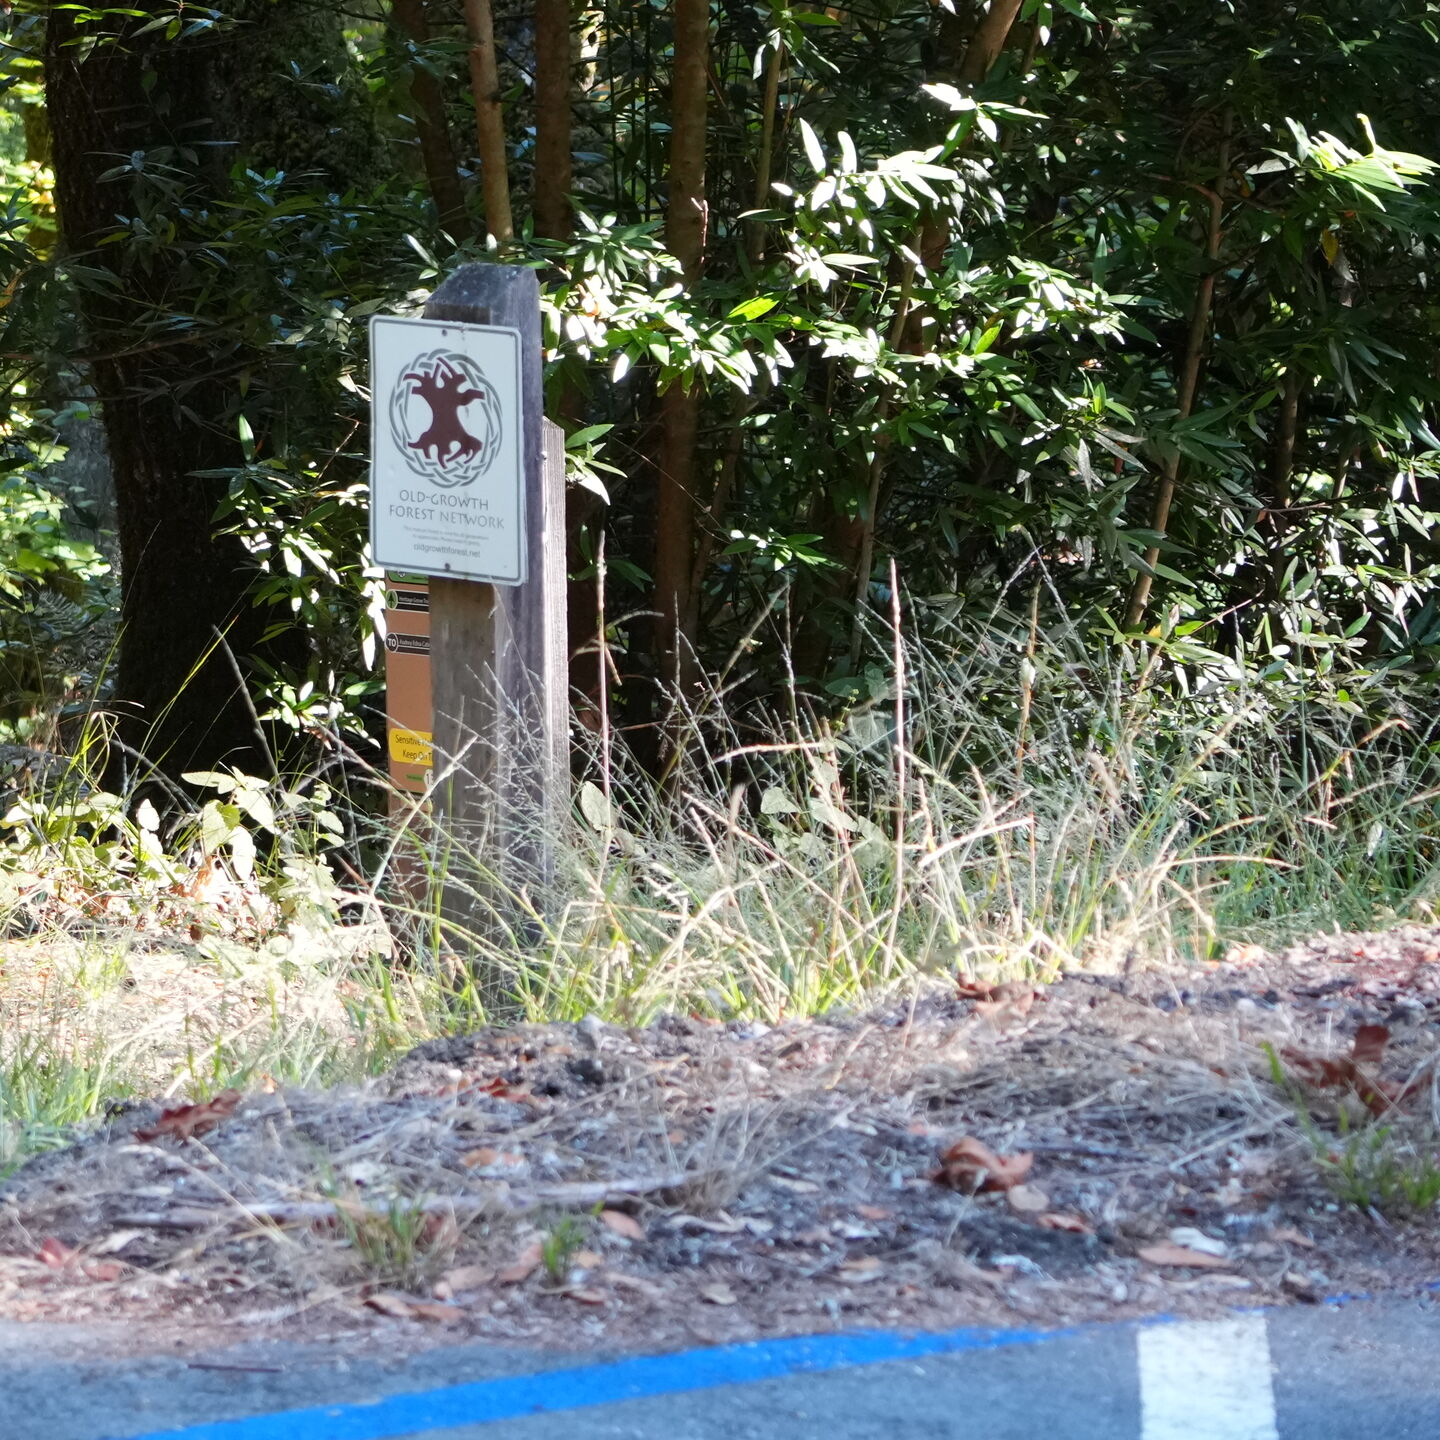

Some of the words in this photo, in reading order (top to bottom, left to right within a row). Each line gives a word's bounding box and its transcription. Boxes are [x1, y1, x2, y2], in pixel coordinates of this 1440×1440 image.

[399, 489, 489, 511] OLD-GROWTH
[389, 504, 435, 520] FOREST
[440, 511, 505, 529] NETWORK
[413, 543, 481, 558] oldgrowthforest.net
[387, 638, 397, 647] TO
[395, 734, 420, 746] Sensitive
[402, 749, 417, 760] Keep
